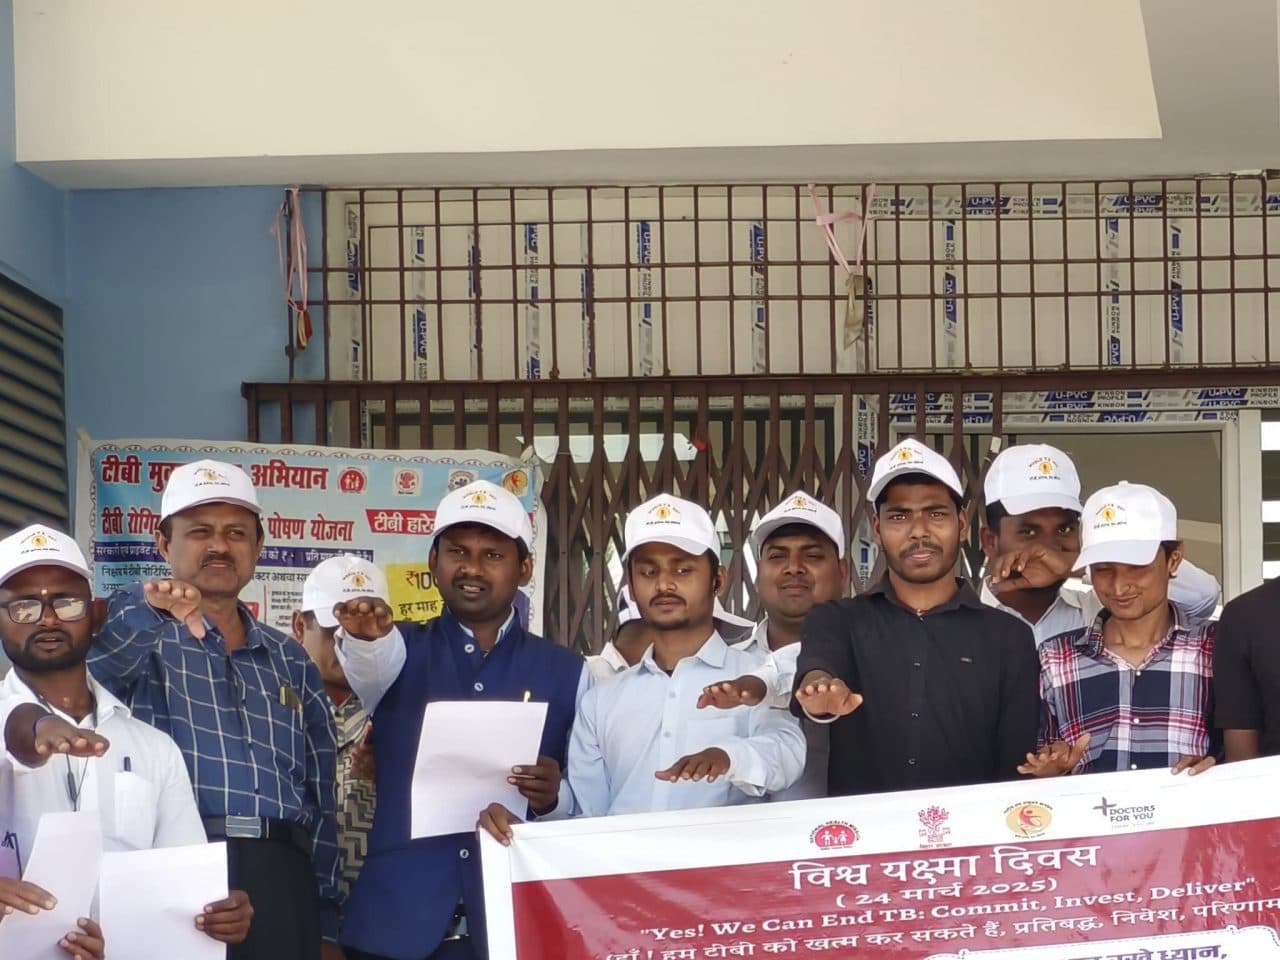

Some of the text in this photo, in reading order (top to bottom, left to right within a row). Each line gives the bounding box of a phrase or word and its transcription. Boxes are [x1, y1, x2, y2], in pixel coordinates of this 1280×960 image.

[101, 455, 142, 484] टीबी
[101, 507, 356, 542] टीबी पोषण योजना
[374, 513, 404, 532] टीबी
[398, 600, 438, 616] हर माह
[1109, 804, 1156, 816] DOCTORS
[1110, 811, 1154, 823] FOR YOU
[789, 845, 1101, 890] विश्व यक्ष्मा दिवस
[855, 877, 1057, 905] 24 मार्च 2025)
[640, 877, 1256, 940] "Yes! We Can End TB: Commit, Invest, Deliver"
[703, 941, 755, 958] टीबी
[762, 938, 798, 953] को
[804, 932, 860, 950] खत्म
[865, 932, 905, 945] कर
[912, 924, 977, 942] सकते
[984, 920, 1006, 938] हैं,
[1012, 911, 1103, 934] प्रतिबद्ध,
[1112, 907, 1186, 926] निवेश,
